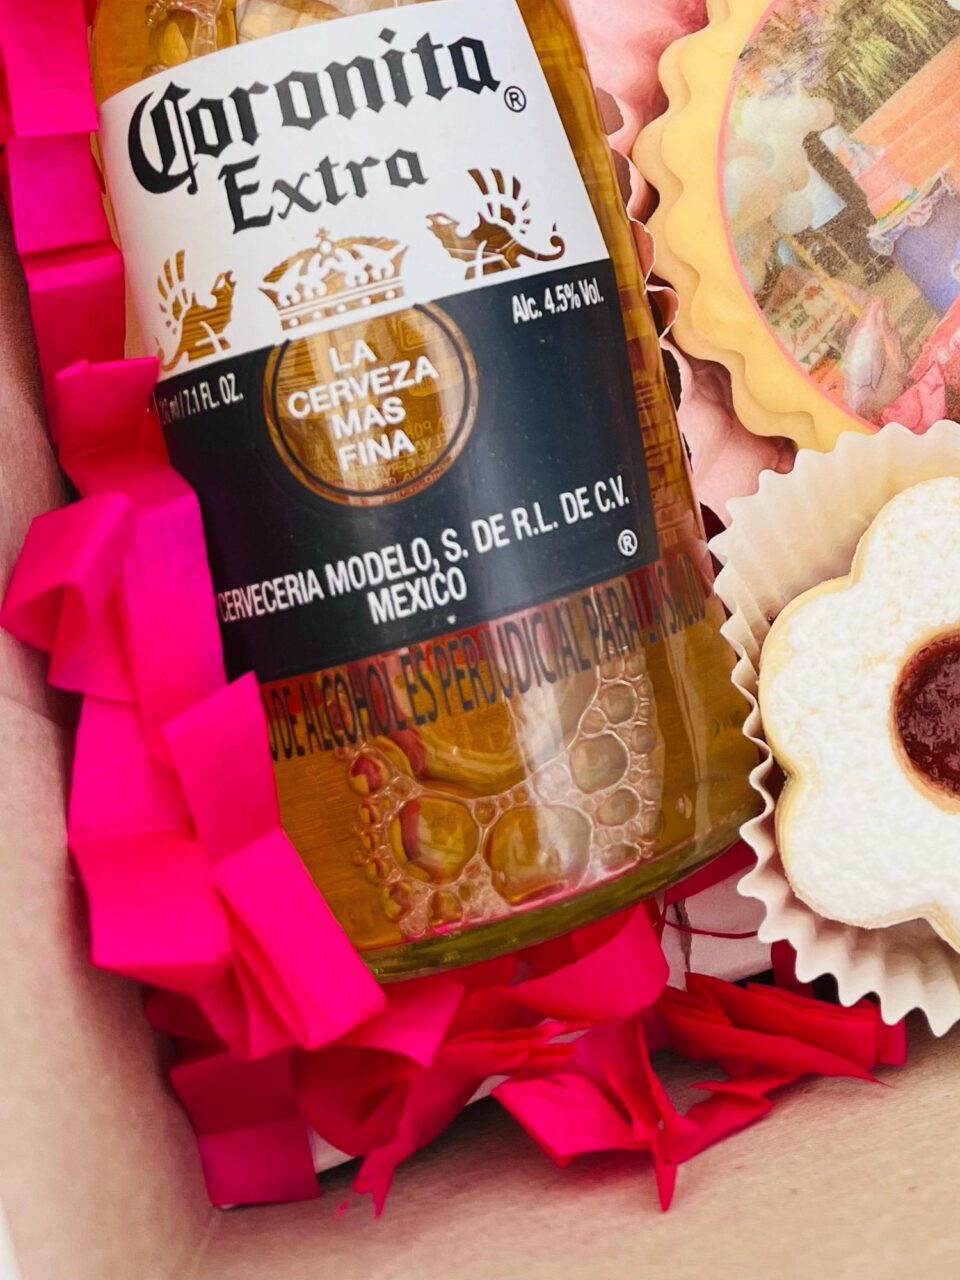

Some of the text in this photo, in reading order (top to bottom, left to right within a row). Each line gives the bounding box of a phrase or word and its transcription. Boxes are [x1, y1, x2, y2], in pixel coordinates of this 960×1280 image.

[127, 27, 501, 195] Coronita
[217, 147, 430, 235] Extra
[511, 277, 605, 324] Alc. 4.5% Vol.
[328, 338, 378, 374] LA
[218, 372, 244, 405] OZ.
[287, 355, 440, 419] CERVEZA
[331, 396, 407, 440] MAS
[338, 429, 417, 477] FINA
[217, 474, 630, 623] CERVECERIA MODELO, S. DE R.L. DE C.V.
[367, 566, 467, 625] MEXICO
[300, 659, 407, 754] ALCOHOL
[400, 645, 438, 726] ES
[431, 600, 592, 718] PERJUDICIAL
[581, 580, 644, 666] PARA
